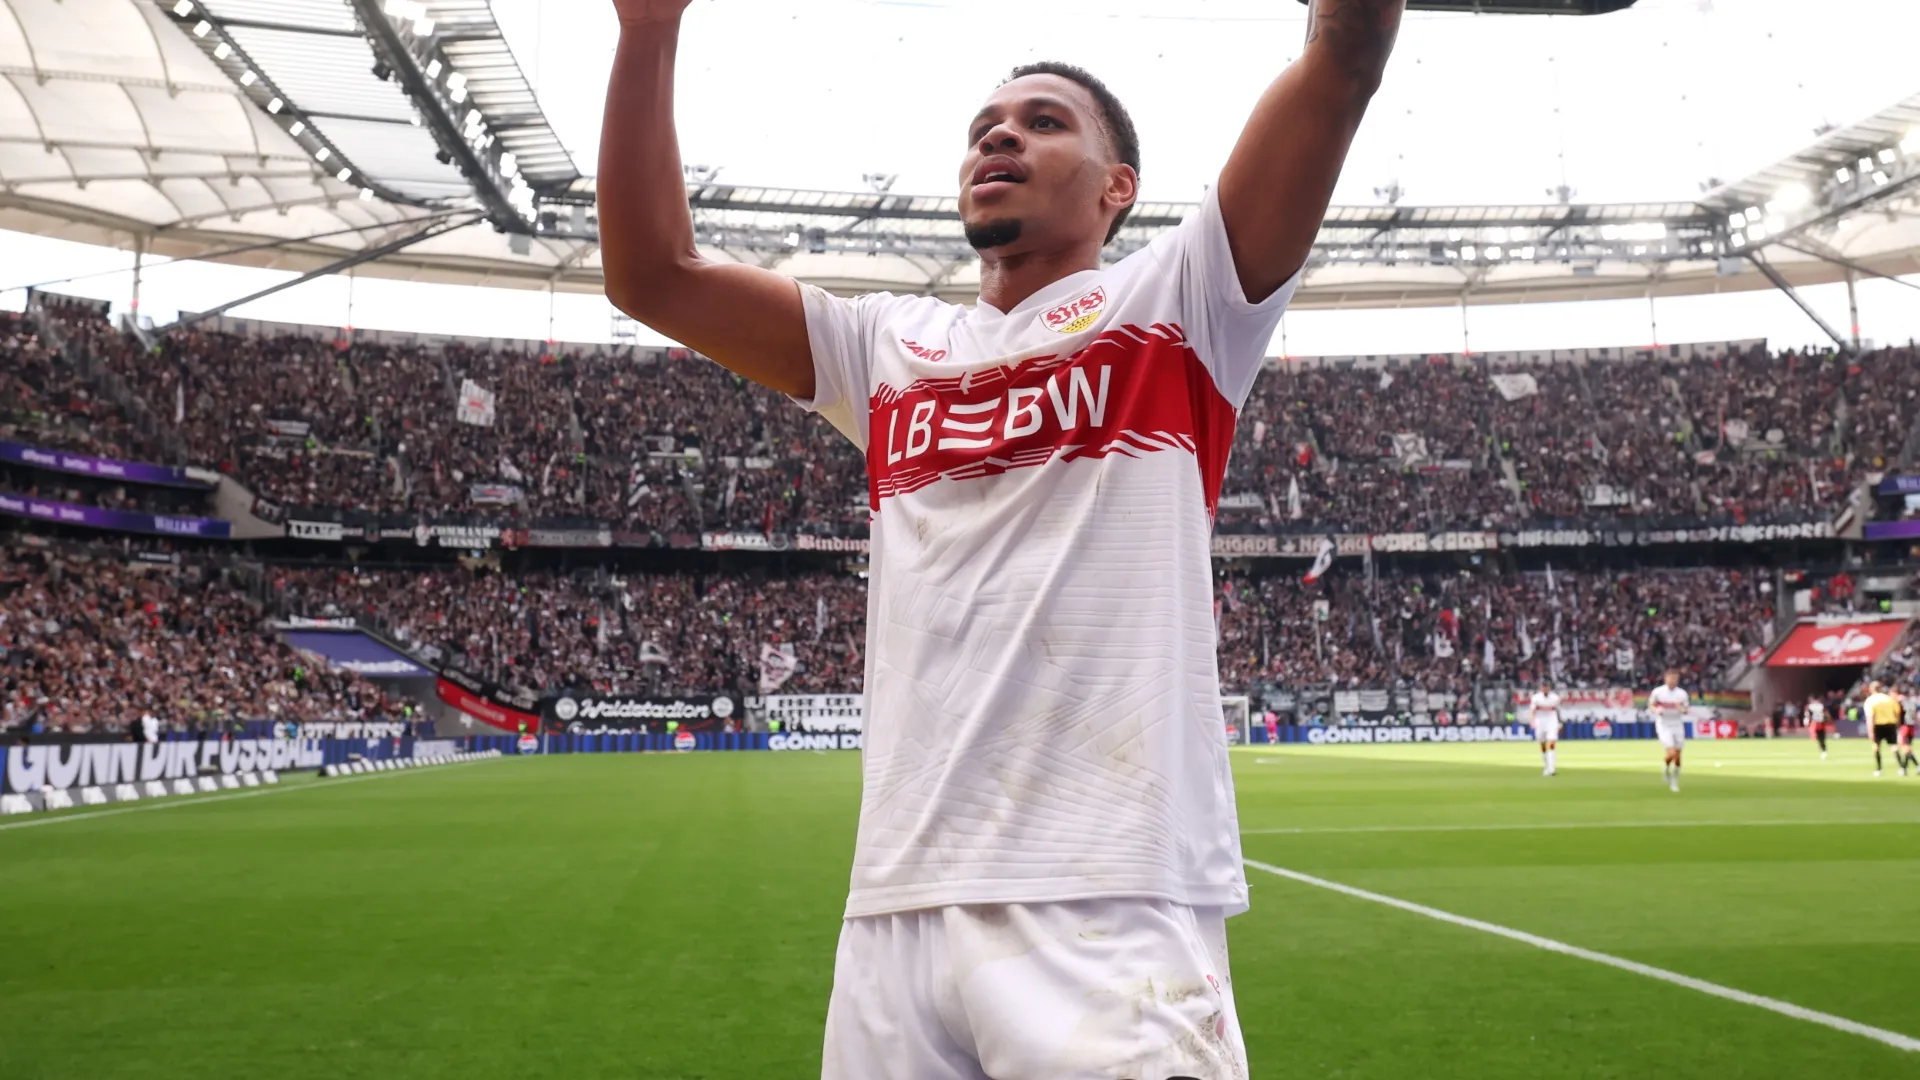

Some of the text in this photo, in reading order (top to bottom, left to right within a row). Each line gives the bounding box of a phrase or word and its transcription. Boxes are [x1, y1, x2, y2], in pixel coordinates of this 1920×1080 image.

[900, 338, 948, 363] JAKO
[579, 698, 711, 719] Waldstadion
[768, 730, 838, 750] GÖNN
[1308, 724, 1533, 743] GÖNN DIR FUSSBALL
